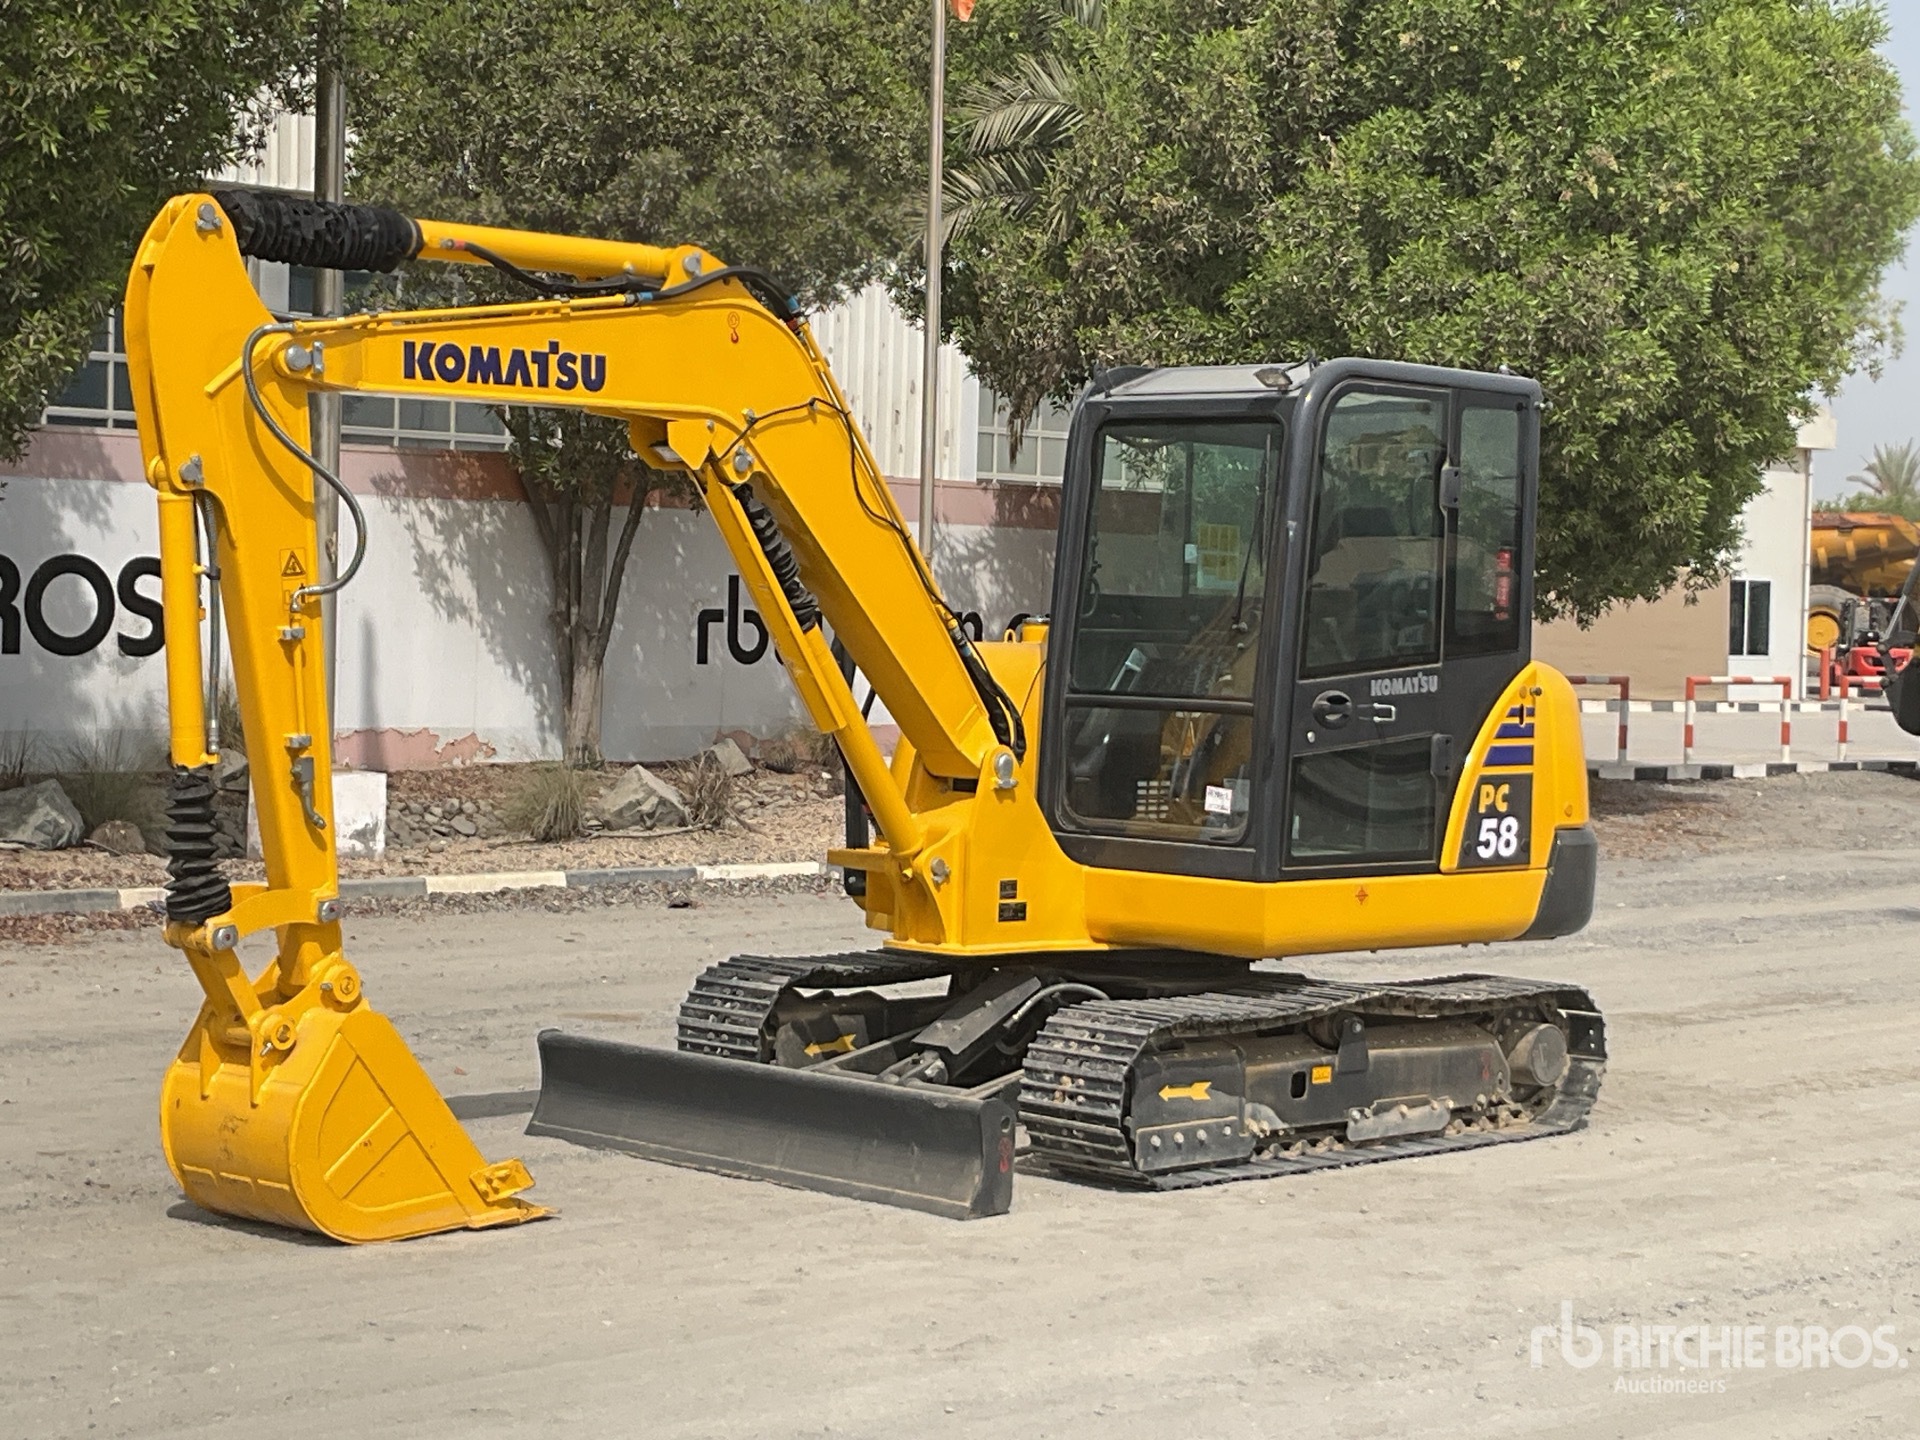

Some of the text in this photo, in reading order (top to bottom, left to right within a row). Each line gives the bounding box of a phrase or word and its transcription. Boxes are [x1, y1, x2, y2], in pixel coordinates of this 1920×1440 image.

[403, 340, 607, 392] KOMATSU
[1370, 671, 1438, 696] KOMATSU
[1478, 783, 1510, 813] PC
[1476, 815, 1519, 859] 58
